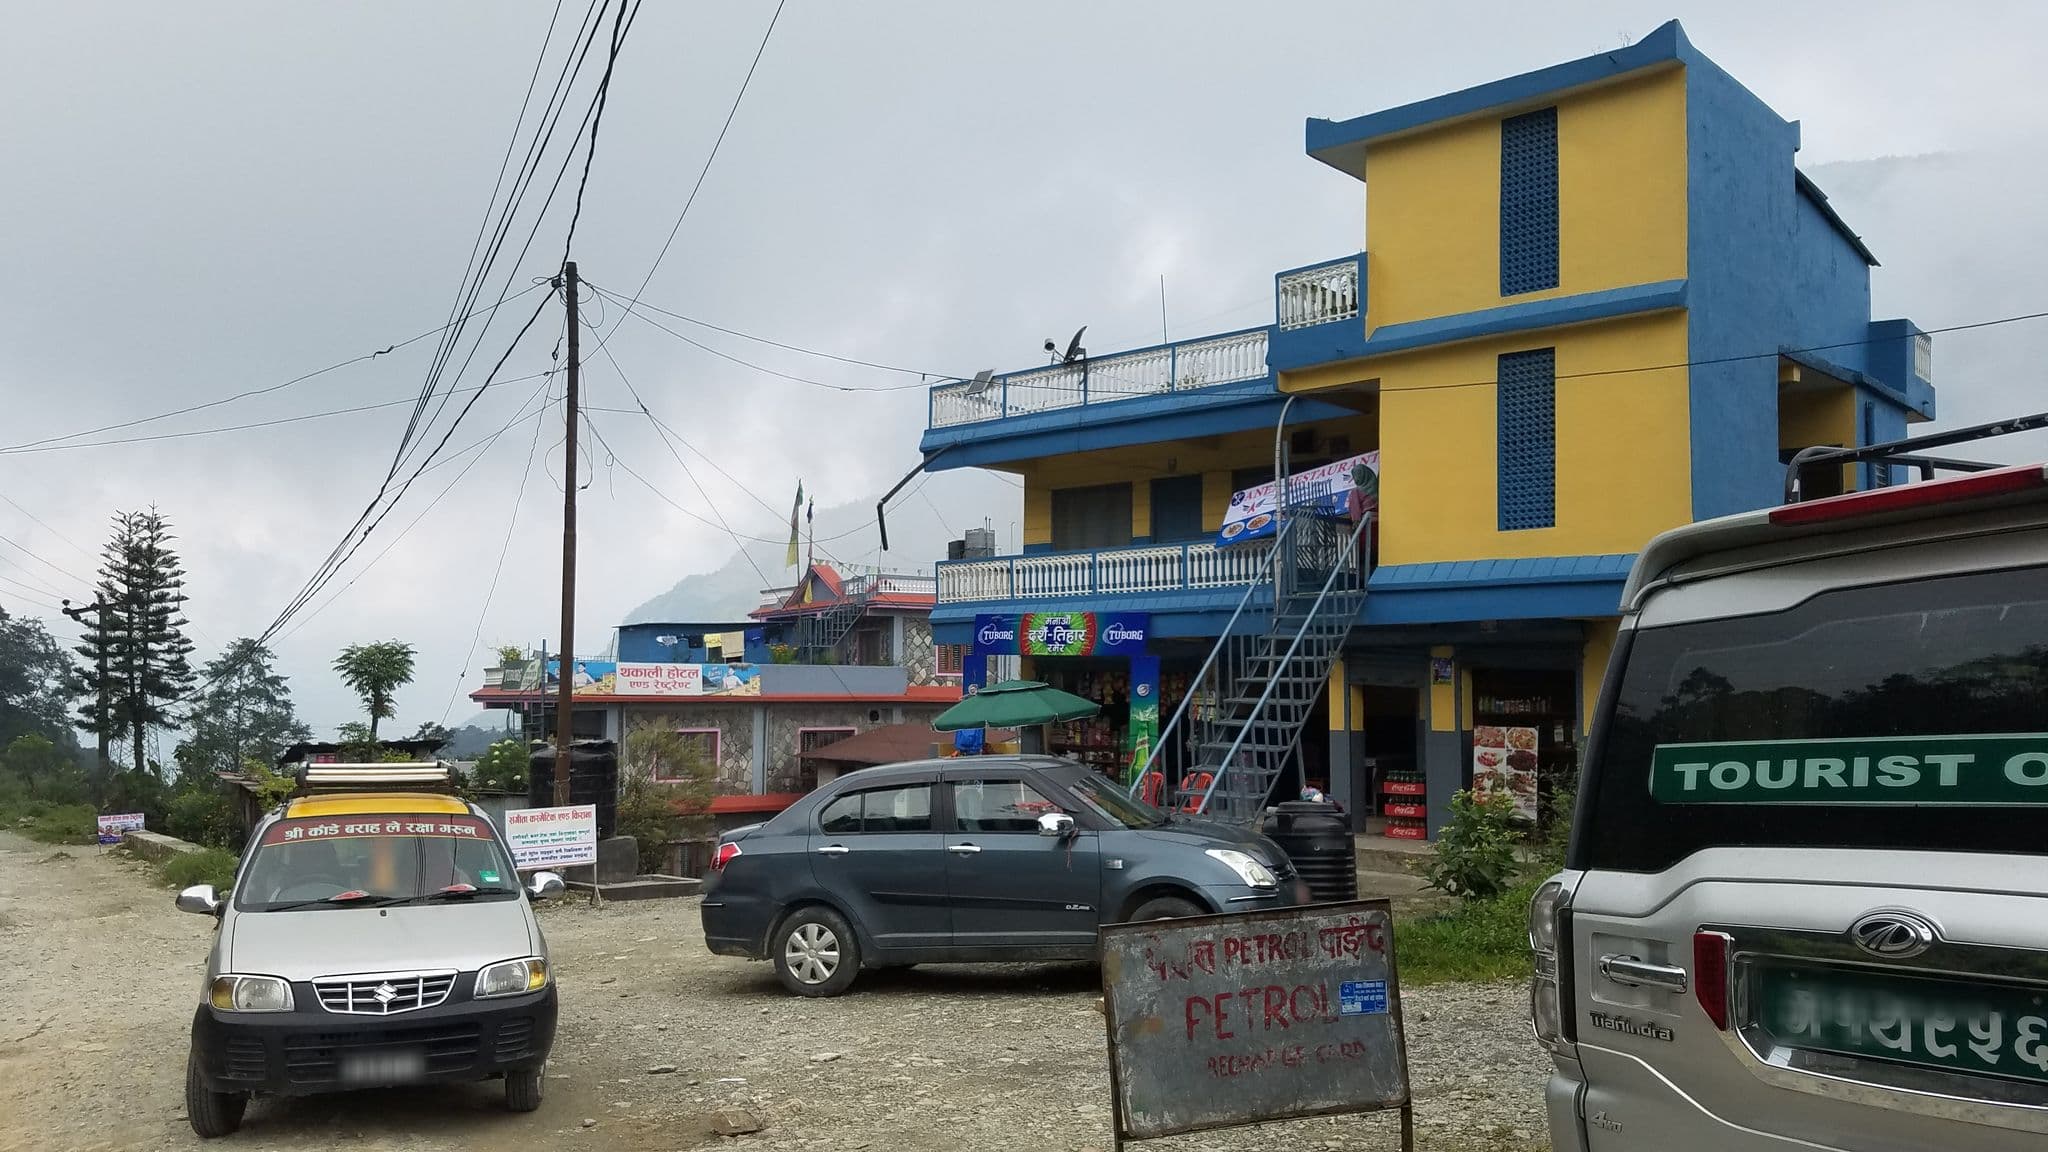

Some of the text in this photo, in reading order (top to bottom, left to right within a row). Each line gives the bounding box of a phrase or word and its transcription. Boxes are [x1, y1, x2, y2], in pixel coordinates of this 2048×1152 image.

[984, 630, 1014, 641] TUBORG
[1109, 630, 1143, 641] TUBORG
[619, 665, 663, 678] थकाली
[667, 665, 700, 680] होटल
[1673, 753, 1975, 791] TOURIST
[285, 825, 304, 841] श्री
[386, 820, 401, 833] ले
[405, 822, 434, 834] रक्षा
[1223, 931, 1316, 966] PETROL
[1185, 983, 1339, 1041] PETROL
